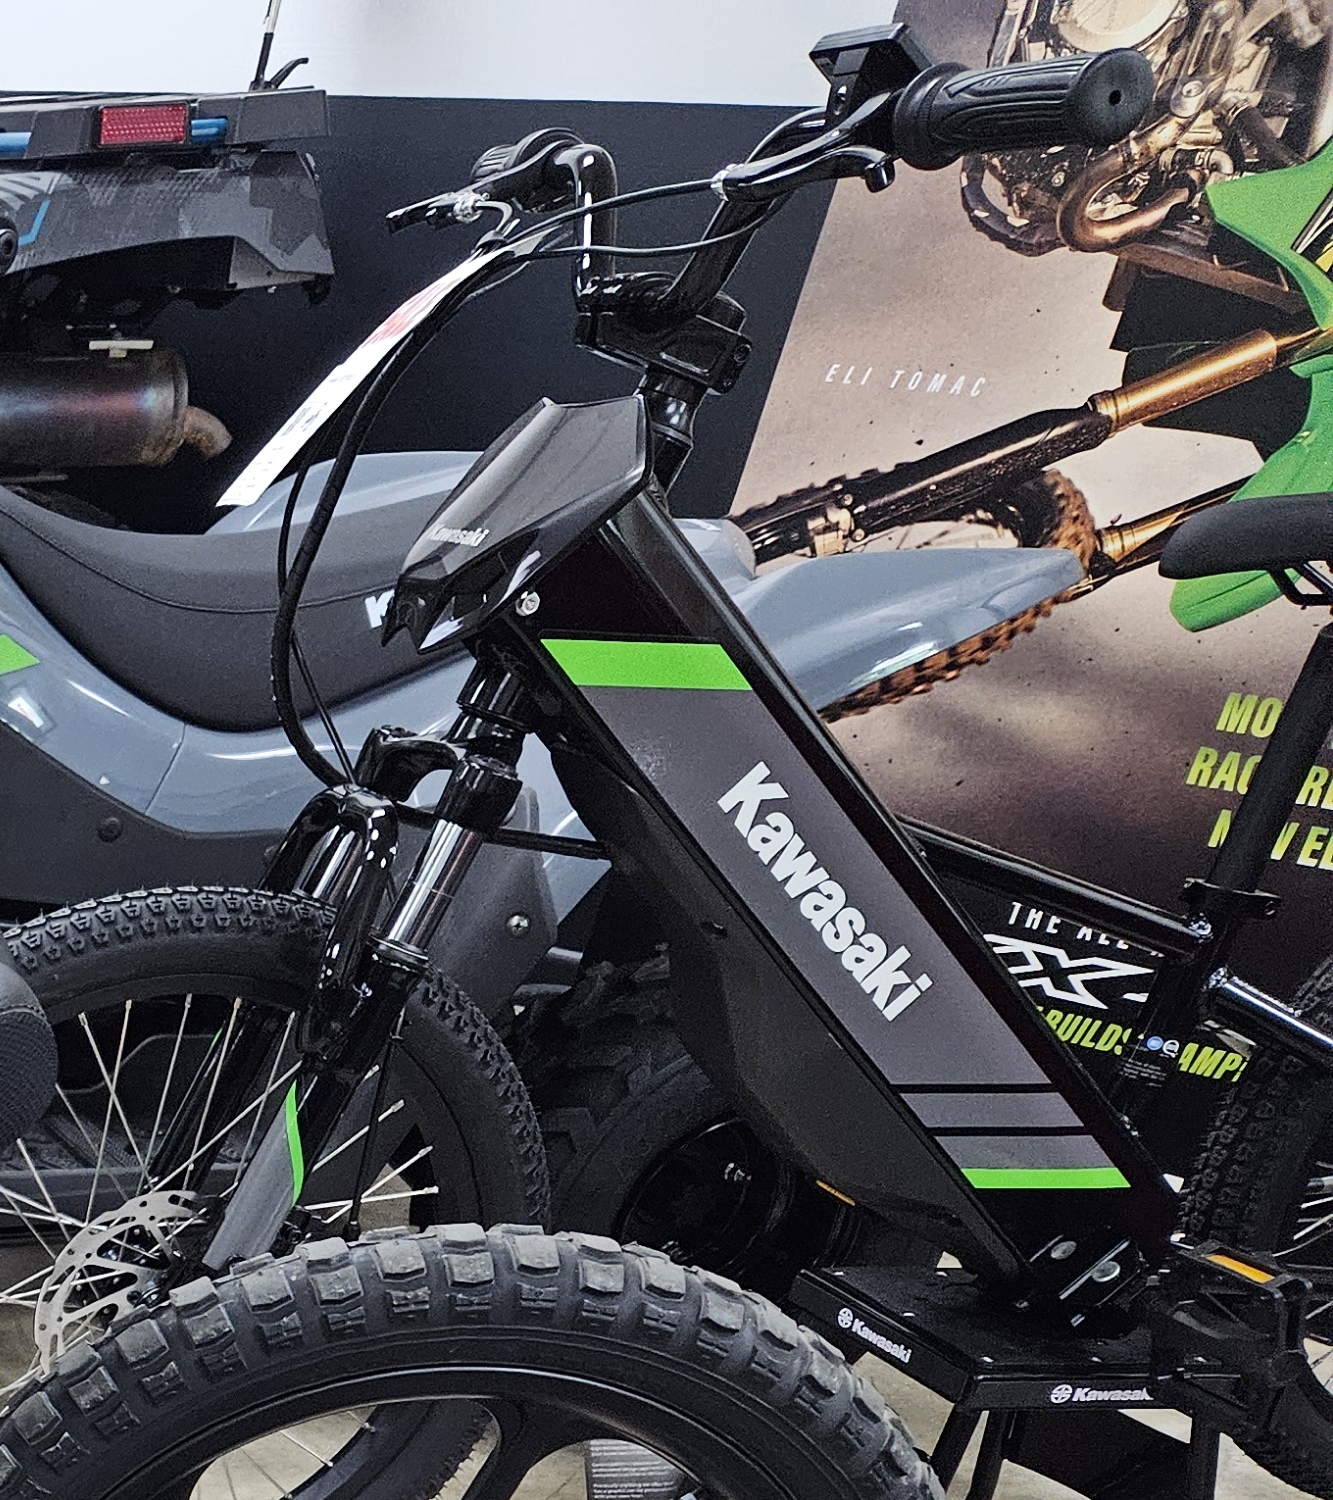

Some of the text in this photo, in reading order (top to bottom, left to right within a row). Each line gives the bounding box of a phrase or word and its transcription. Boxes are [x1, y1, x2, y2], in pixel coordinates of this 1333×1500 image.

[825, 363, 987, 398] ELI TOMAC
[425, 523, 490, 547] Kawasaki
[717, 760, 933, 1022] Kawasaki
[851, 1317, 912, 1363] Kawasaki
[1071, 1386, 1154, 1403] Kawasak
